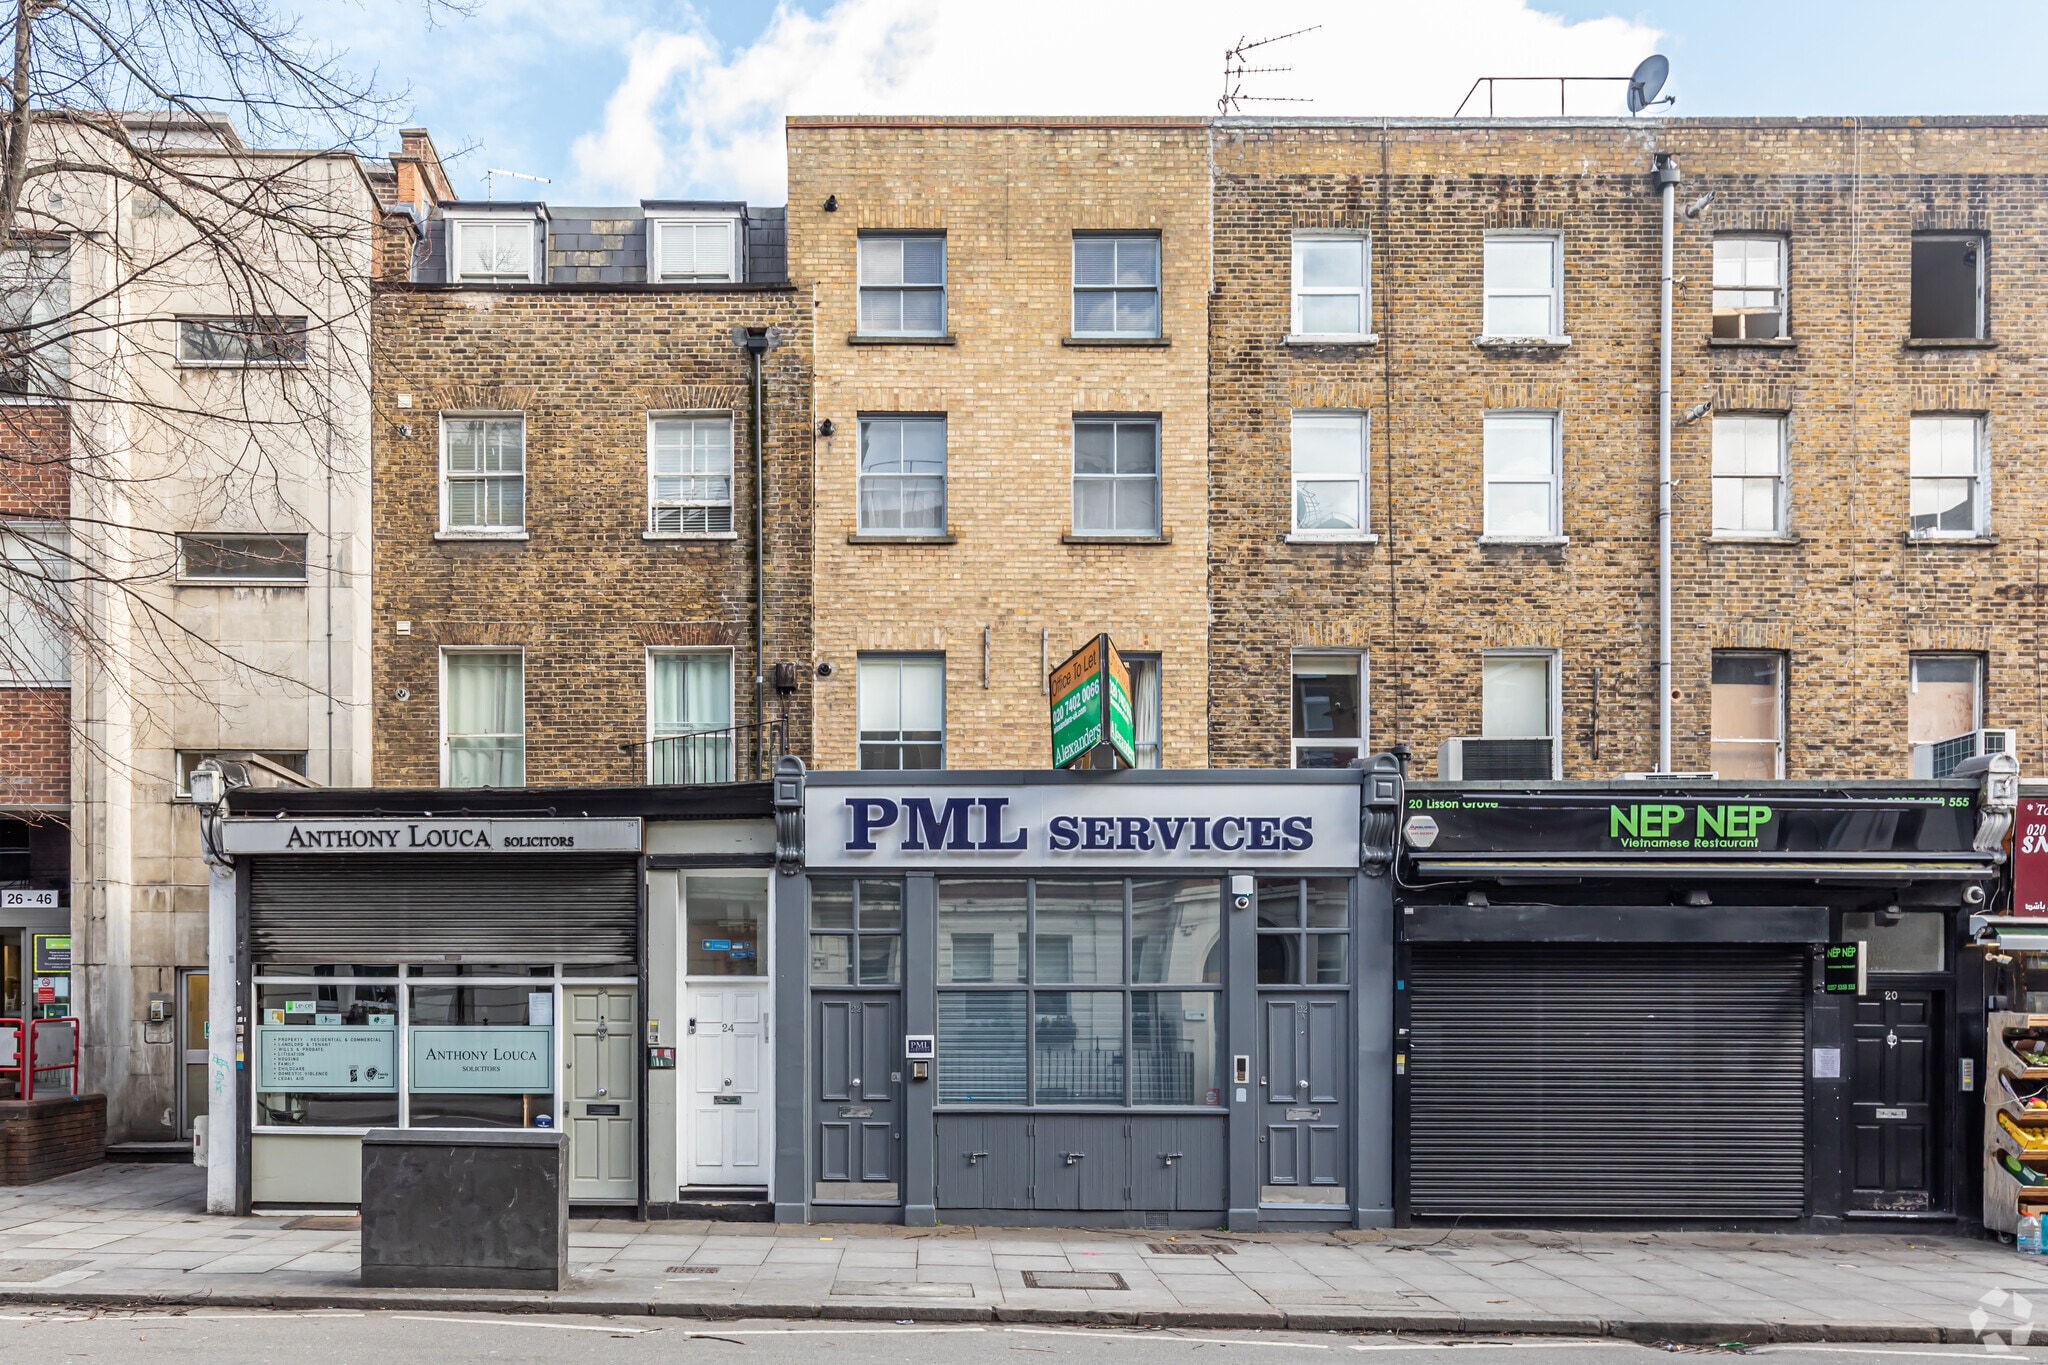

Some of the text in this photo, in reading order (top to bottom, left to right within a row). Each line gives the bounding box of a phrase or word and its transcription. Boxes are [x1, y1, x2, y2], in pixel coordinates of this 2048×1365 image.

[1051, 672, 1072, 697] Office
[1072, 661, 1082, 680] To
[1083, 649, 1097, 673] Let
[1052, 705, 1064, 725] 020
[1081, 678, 1100, 703] 0066
[1055, 722, 1102, 766] Alexanders
[1408, 798, 1423, 809] 20
[1426, 798, 1459, 809] Lisson
[1948, 797, 1970, 807] 555
[845, 797, 1314, 851] PML SERVICES
[2026, 823, 2047, 836] 020
[285, 825, 575, 848] ANTHONY LOUCA SOLICITORS
[1620, 837, 1760, 848] Vietnamese Restaurant
[7, 893, 24, 905] 26
[36, 893, 52, 905] 46
[1884, 990, 1898, 1001] 20
[850, 1005, 862, 1013] 22
[721, 1023, 735, 1033] 24
[910, 1041, 930, 1049] PML
[425, 1048, 537, 1061] ANTHONY LOUCA
